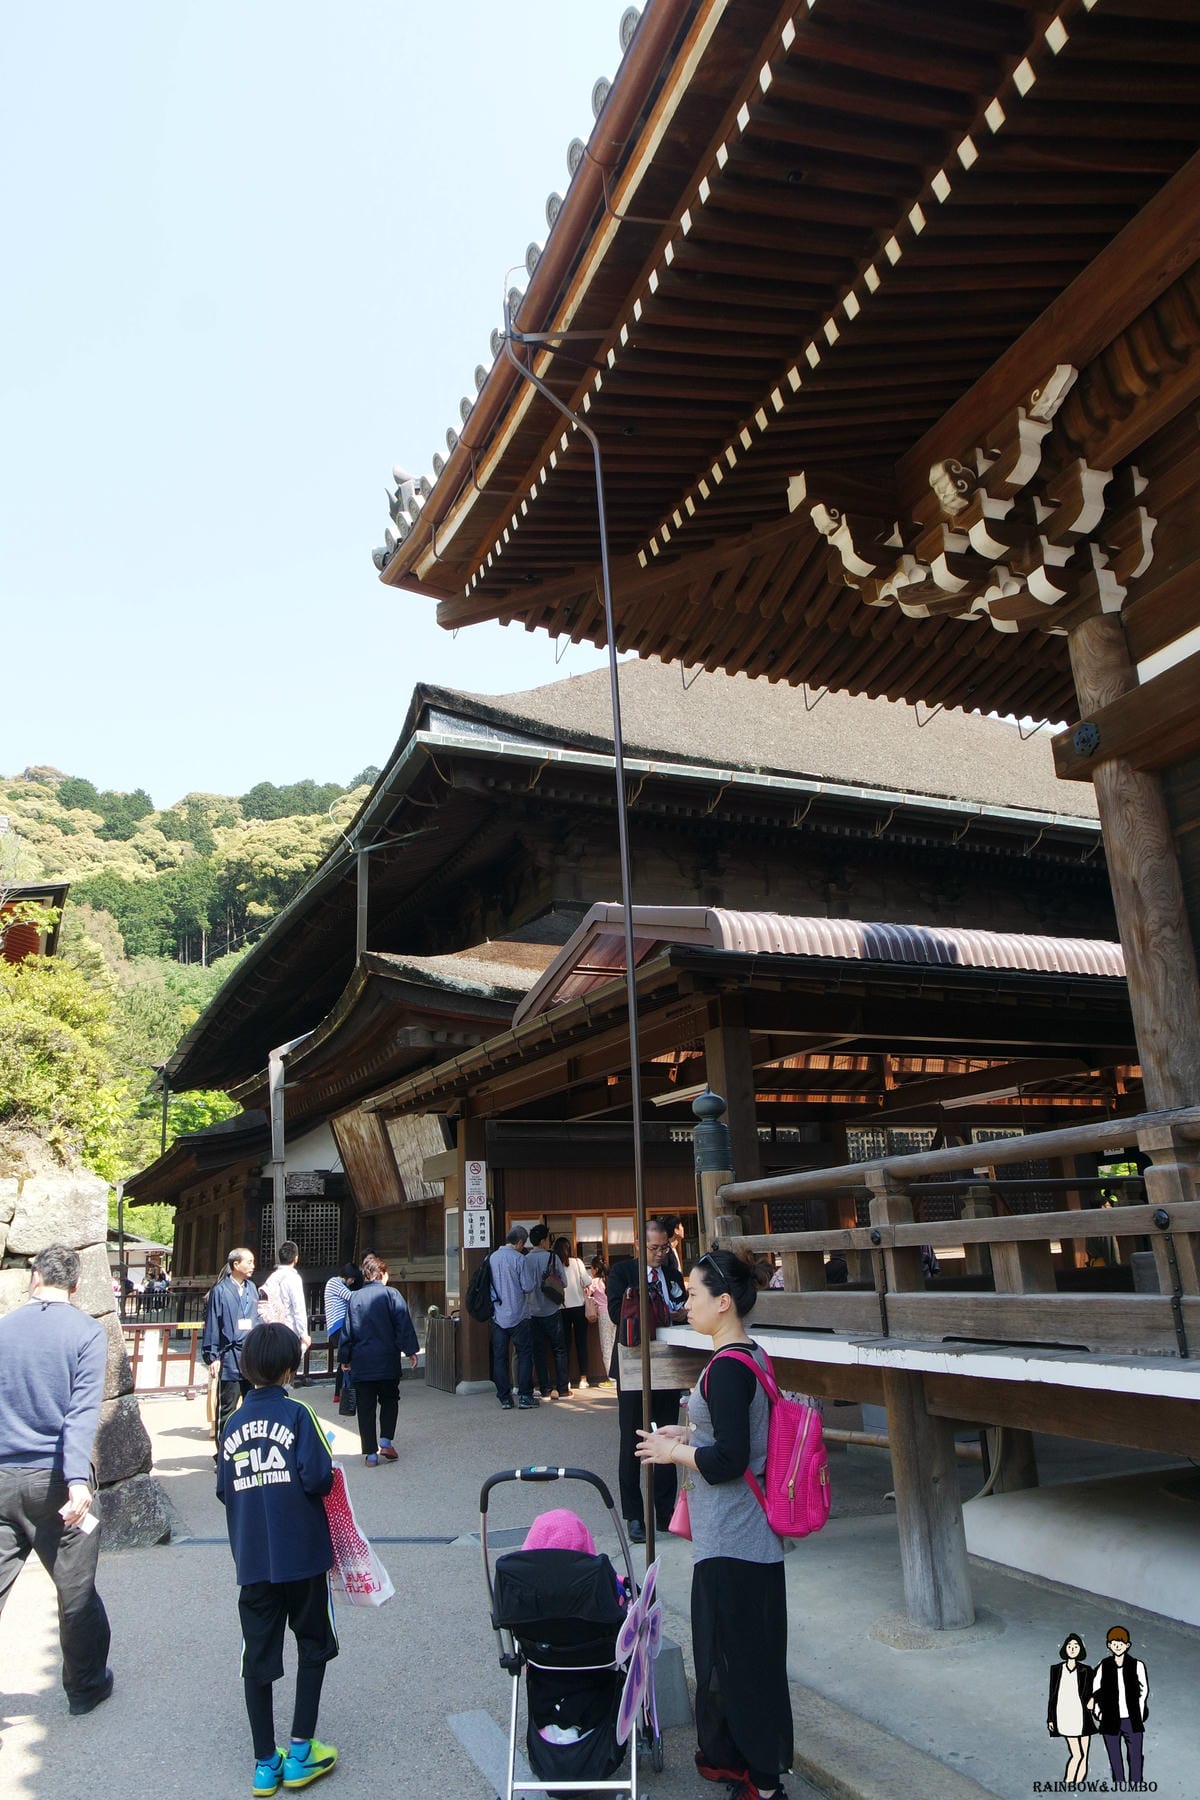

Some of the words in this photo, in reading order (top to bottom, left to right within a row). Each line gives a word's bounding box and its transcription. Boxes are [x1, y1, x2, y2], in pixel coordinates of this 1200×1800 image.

[223, 1429, 243, 1461] FUN
[242, 1420, 268, 1441] FEEL
[269, 1422, 295, 1450] LIFE
[233, 1446, 286, 1477] FILA
[263, 1470, 291, 1485] ITALIA
